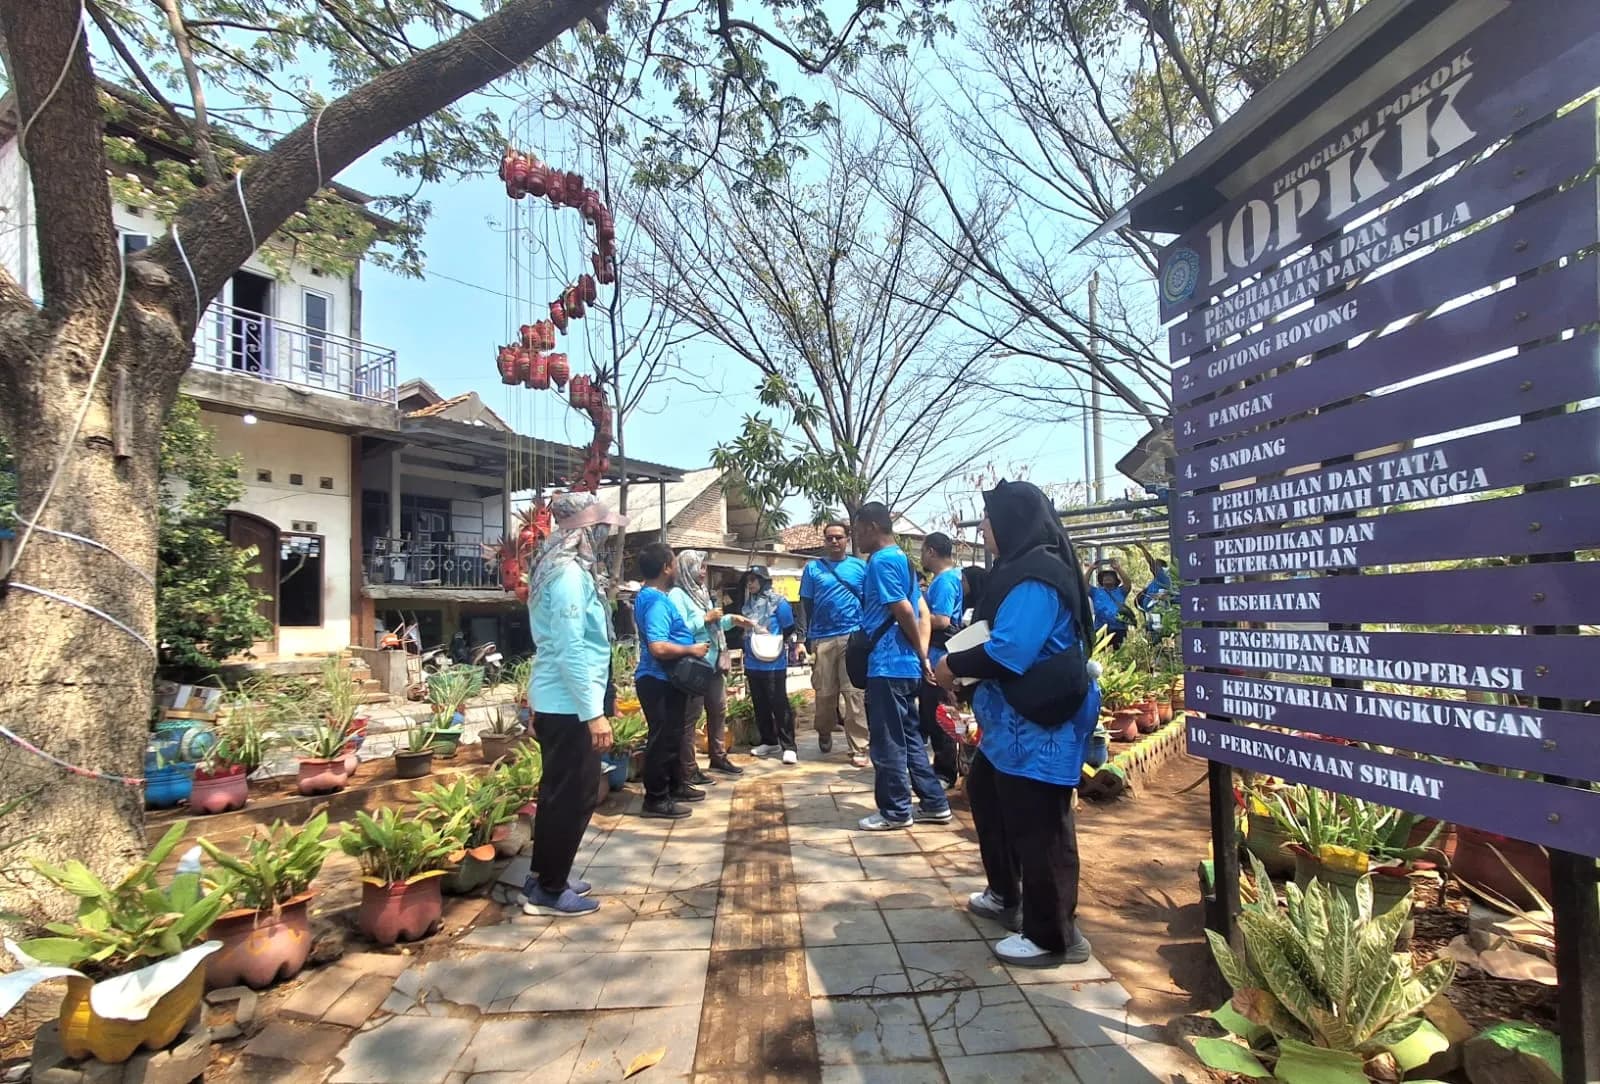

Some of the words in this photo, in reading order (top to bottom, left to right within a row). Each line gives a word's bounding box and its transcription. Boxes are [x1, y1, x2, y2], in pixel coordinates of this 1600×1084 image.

[1272, 120, 1370, 198] PROGRAM
[1376, 47, 1475, 127] POKOK
[1180, 331, 1193, 347] 1.
[1204, 246, 1334, 327] PENGHAYATAN
[1339, 217, 1389, 258] DAN
[1205, 278, 1321, 343] PENGAMALAN
[1325, 201, 1472, 287] PANCASILA
[1181, 374, 1195, 390] 2.
[1207, 338, 1272, 379] GOTONG
[1275, 300, 1360, 351] ROYONG
[1183, 420, 1197, 436] 3.
[1208, 394, 1274, 428] PANGAN
[1184, 463, 1198, 480] 4.
[1210, 438, 1287, 473] SANDANG
[1187, 510, 1201, 525] 5.
[1212, 474, 1323, 512] PERUMAHAN
[1328, 465, 1373, 490] DAN
[1379, 449, 1449, 482] TATA
[1213, 502, 1289, 530] LAKSANA
[1292, 487, 1372, 519] RUMAH
[1378, 467, 1490, 503] TANGGA
[1188, 551, 1202, 566] 6.
[1214, 528, 1324, 556] PENDIDIKAN
[1329, 522, 1376, 545] DAN
[1215, 547, 1358, 575] KETERAMPILAN
[1191, 597, 1206, 612] 7.
[1217, 592, 1322, 612] KESEHATAN
[1193, 639, 1207, 654] 8.
[1219, 630, 1371, 655] PENGEMBANGAN
[1219, 648, 1325, 674] KEHIDUPAN
[1329, 656, 1525, 692] BERKOPERASI
[1196, 685, 1210, 700] 9.
[1222, 679, 1349, 712] KELESTARIAN
[1354, 694, 1545, 740] LINGKUNGAN
[1223, 698, 1278, 721] HIDUP
[1190, 727, 1212, 746] 10.
[1220, 734, 1354, 780] PERENCANAAN
[1359, 764, 1445, 800] SEHAT
